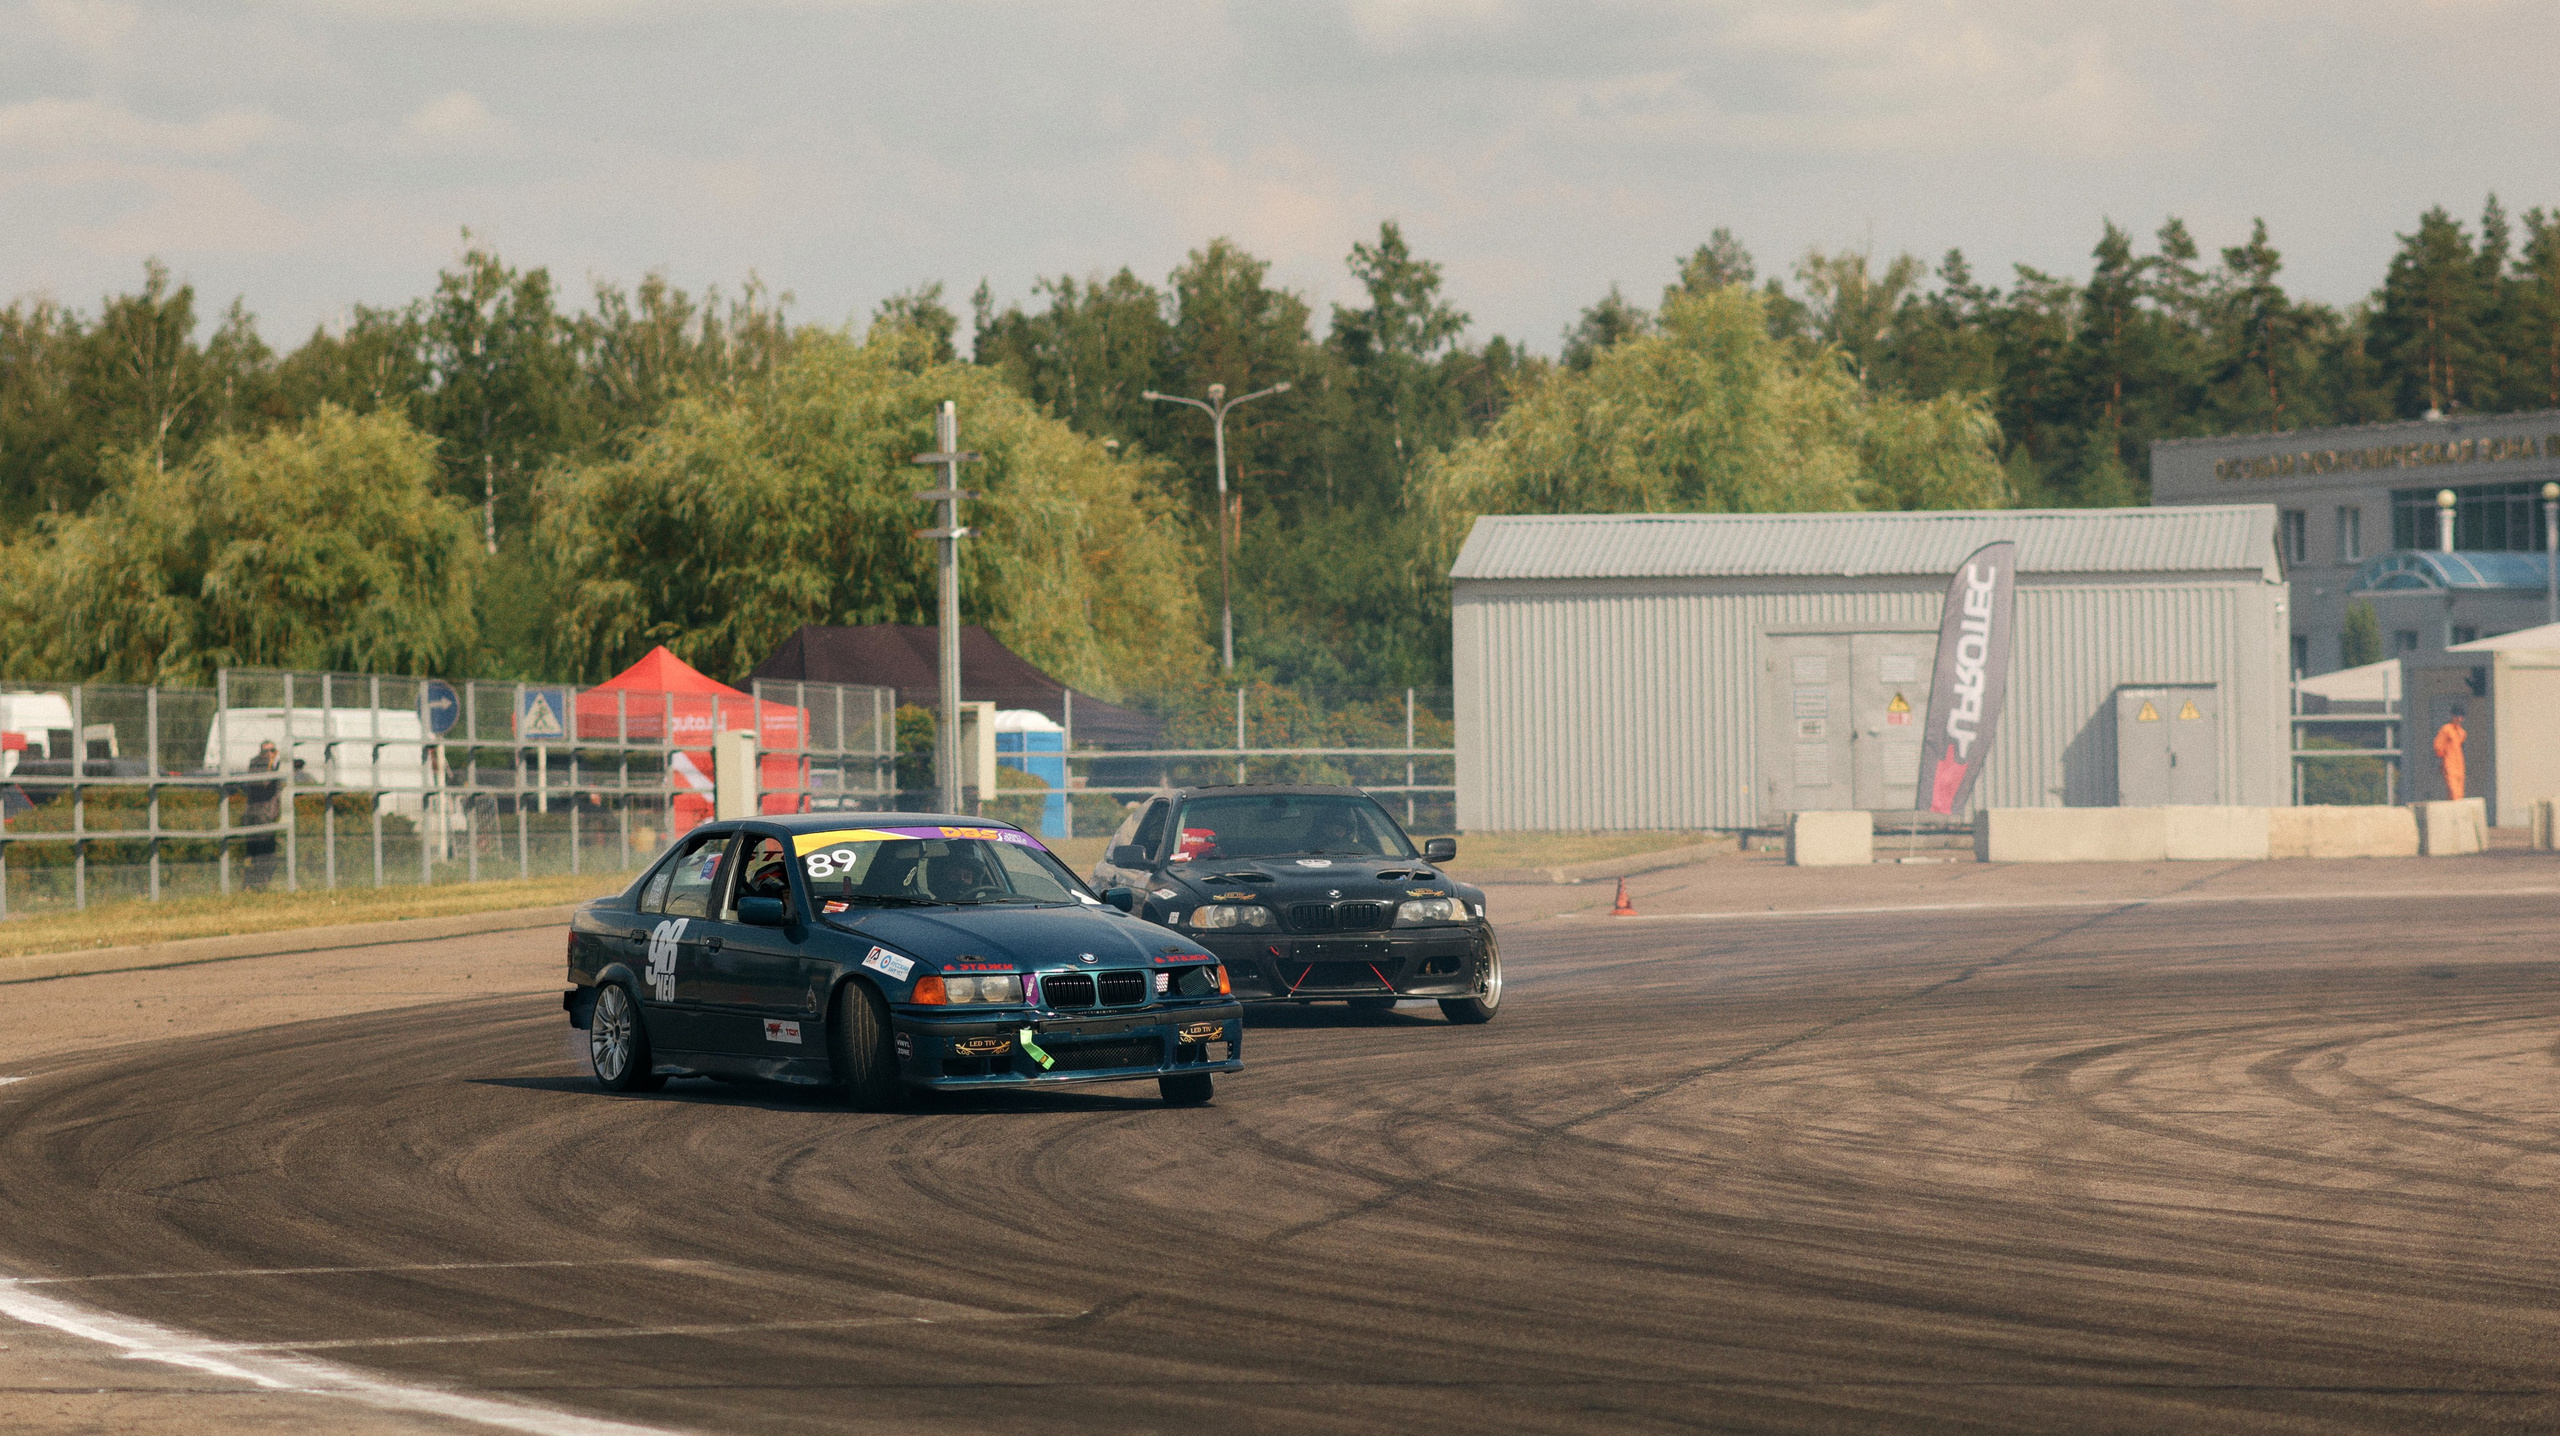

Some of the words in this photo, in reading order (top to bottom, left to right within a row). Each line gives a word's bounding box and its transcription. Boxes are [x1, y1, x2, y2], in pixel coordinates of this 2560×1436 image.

[806, 849, 857, 878] 89
[645, 917, 690, 986] 98
[655, 973, 676, 1002] NEO
[896, 1039, 911, 1048] VINYL
[897, 1047, 910, 1056] ZONE
